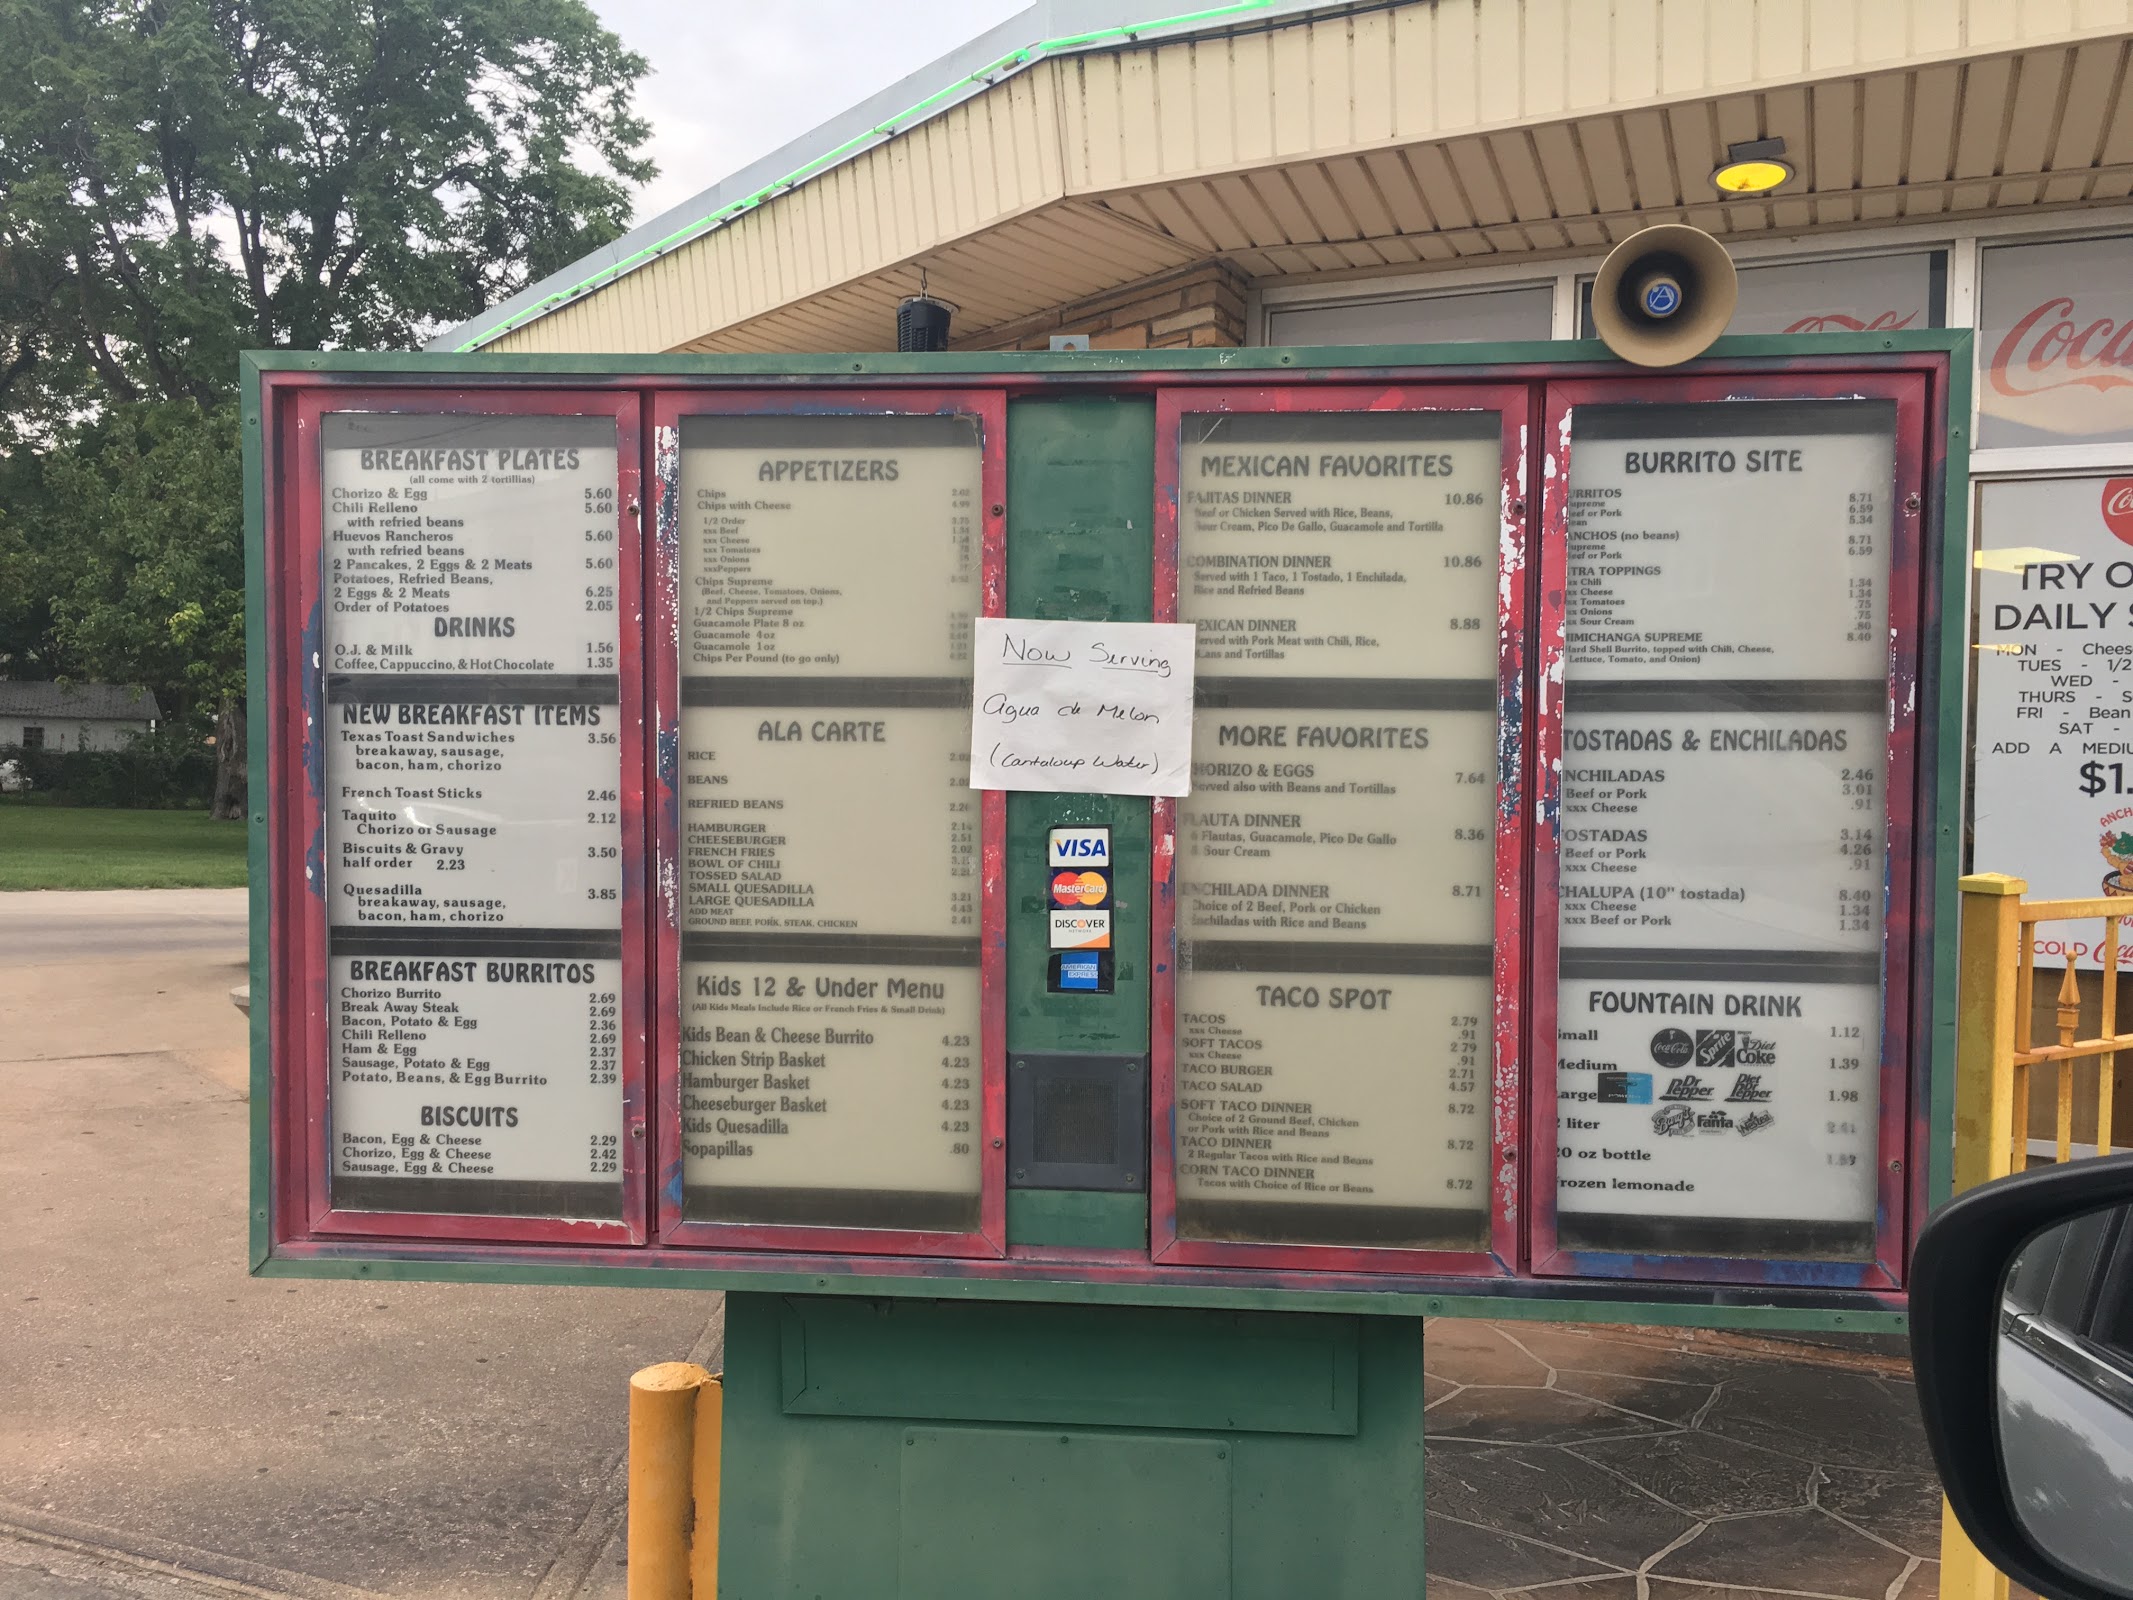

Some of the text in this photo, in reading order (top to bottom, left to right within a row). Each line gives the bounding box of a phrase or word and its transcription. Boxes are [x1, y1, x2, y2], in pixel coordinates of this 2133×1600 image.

[361, 449, 580, 470] BREAKFAST PLATES
[1201, 454, 1453, 477] MEXICAN FAVORITES
[1625, 450, 1803, 474] BURRITO SITE
[759, 460, 899, 481] APPETIZERS
[410, 475, 425, 484] (all
[429, 476, 454, 484] come
[458, 475, 478, 483] with
[492, 475, 535, 484] tortillias)
[332, 488, 612, 501] Chorizo & Egg 5.60
[1243, 492, 1483, 505] DINNER 10.86
[697, 501, 791, 511] Chips with Cheese
[1621, 530, 1680, 541] (no beans)
[1186, 556, 1482, 567] COMBINATION DINNER 10.86
[1599, 566, 1661, 576] TOPPINGS
[2014, 562, 2094, 590] TRY
[1995, 603, 2116, 630] DAILY
[434, 617, 515, 637] DRINKS
[1248, 619, 1480, 631] DINNER 8.88
[1644, 632, 1702, 642] SUPREME
[335, 642, 613, 656] O.J. & Milk 1.56
[1002, 634, 1171, 677] Now Serving
[1997, 644, 2037, 656] MON
[2018, 658, 2132, 672] TUES 1/2
[2051, 676, 2093, 687] WED
[2019, 691, 2076, 703] THURS
[343, 704, 600, 725] NEW BREAKFAST ITEMS
[1058, 702, 1080, 715] de
[1097, 704, 1159, 724] Melon
[2017, 707, 2131, 719] FRI Bean
[758, 721, 886, 742] ALA CARTE
[2059, 723, 2094, 735] SAT
[341, 731, 616, 744] Texas Toast Sandwiches 3.56
[1219, 726, 1429, 748] MORE FAVORITES
[1564, 729, 1847, 751] TOSTADAS & ENCHILADAS
[1992, 742, 2030, 754] ADD
[2049, 743, 2062, 754] A
[1093, 753, 1158, 774] Water)
[688, 776, 728, 785] BEANS
[1274, 765, 1485, 784] EGGS 7.64
[1566, 784, 1873, 799] Beef or Pork 3.01
[1591, 803, 1638, 813] Cheese
[688, 823, 766, 833] HAMBURGER
[1245, 815, 1485, 840] DINNER 8.36
[688, 835, 786, 845] CHEESEBURGER
[343, 843, 616, 858] Biscuits & Gravy 3.50
[688, 847, 775, 857] FRENCH FRIES
[1055, 839, 1106, 857] VISA
[1053, 884, 1105, 894] MasterCard
[1272, 885, 1481, 898] DINNER 8.71
[1640, 887, 1870, 901] (10" tostada) 8.40
[1056, 919, 1105, 928] DISCOVER
[350, 961, 595, 983] BREAKFAST BURRITOS
[697, 976, 944, 999] Kids 12 & Under Menu
[1256, 986, 1392, 1009] TACO SPOT
[1589, 991, 1802, 1017] FOUNTAIN DRINK
[342, 1002, 615, 1017] Break Away Steak 2.69
[1182, 1014, 1478, 1027] TACOS 2.79
[1830, 1026, 1860, 1037] 1.12
[1700, 1032, 1731, 1064] Sprite
[1750, 1039, 1776, 1050] Diet
[682, 1051, 969, 1070] Chicken Strip Basket 4.23
[1737, 1049, 1776, 1064] Coke
[1829, 1058, 1859, 1069] 1.39
[1182, 1064, 1475, 1079] TACO BURGER 2.71
[1683, 1075, 1702, 1086] Dr
[1667, 1079, 1714, 1098] Pepper
[1829, 1090, 1858, 1102] 1.98
[421, 1106, 518, 1127] BISCUITS
[1697, 1115, 1733, 1128] Fanta
[716, 1118, 969, 1135] Quesadilla 4.23
[1567, 1118, 1600, 1129] liter
[342, 1134, 616, 1147] Bacon, Egg & Cheese 2.29
[1578, 1148, 1651, 1161] oz bottle
[1613, 1178, 1695, 1191] lemonade
